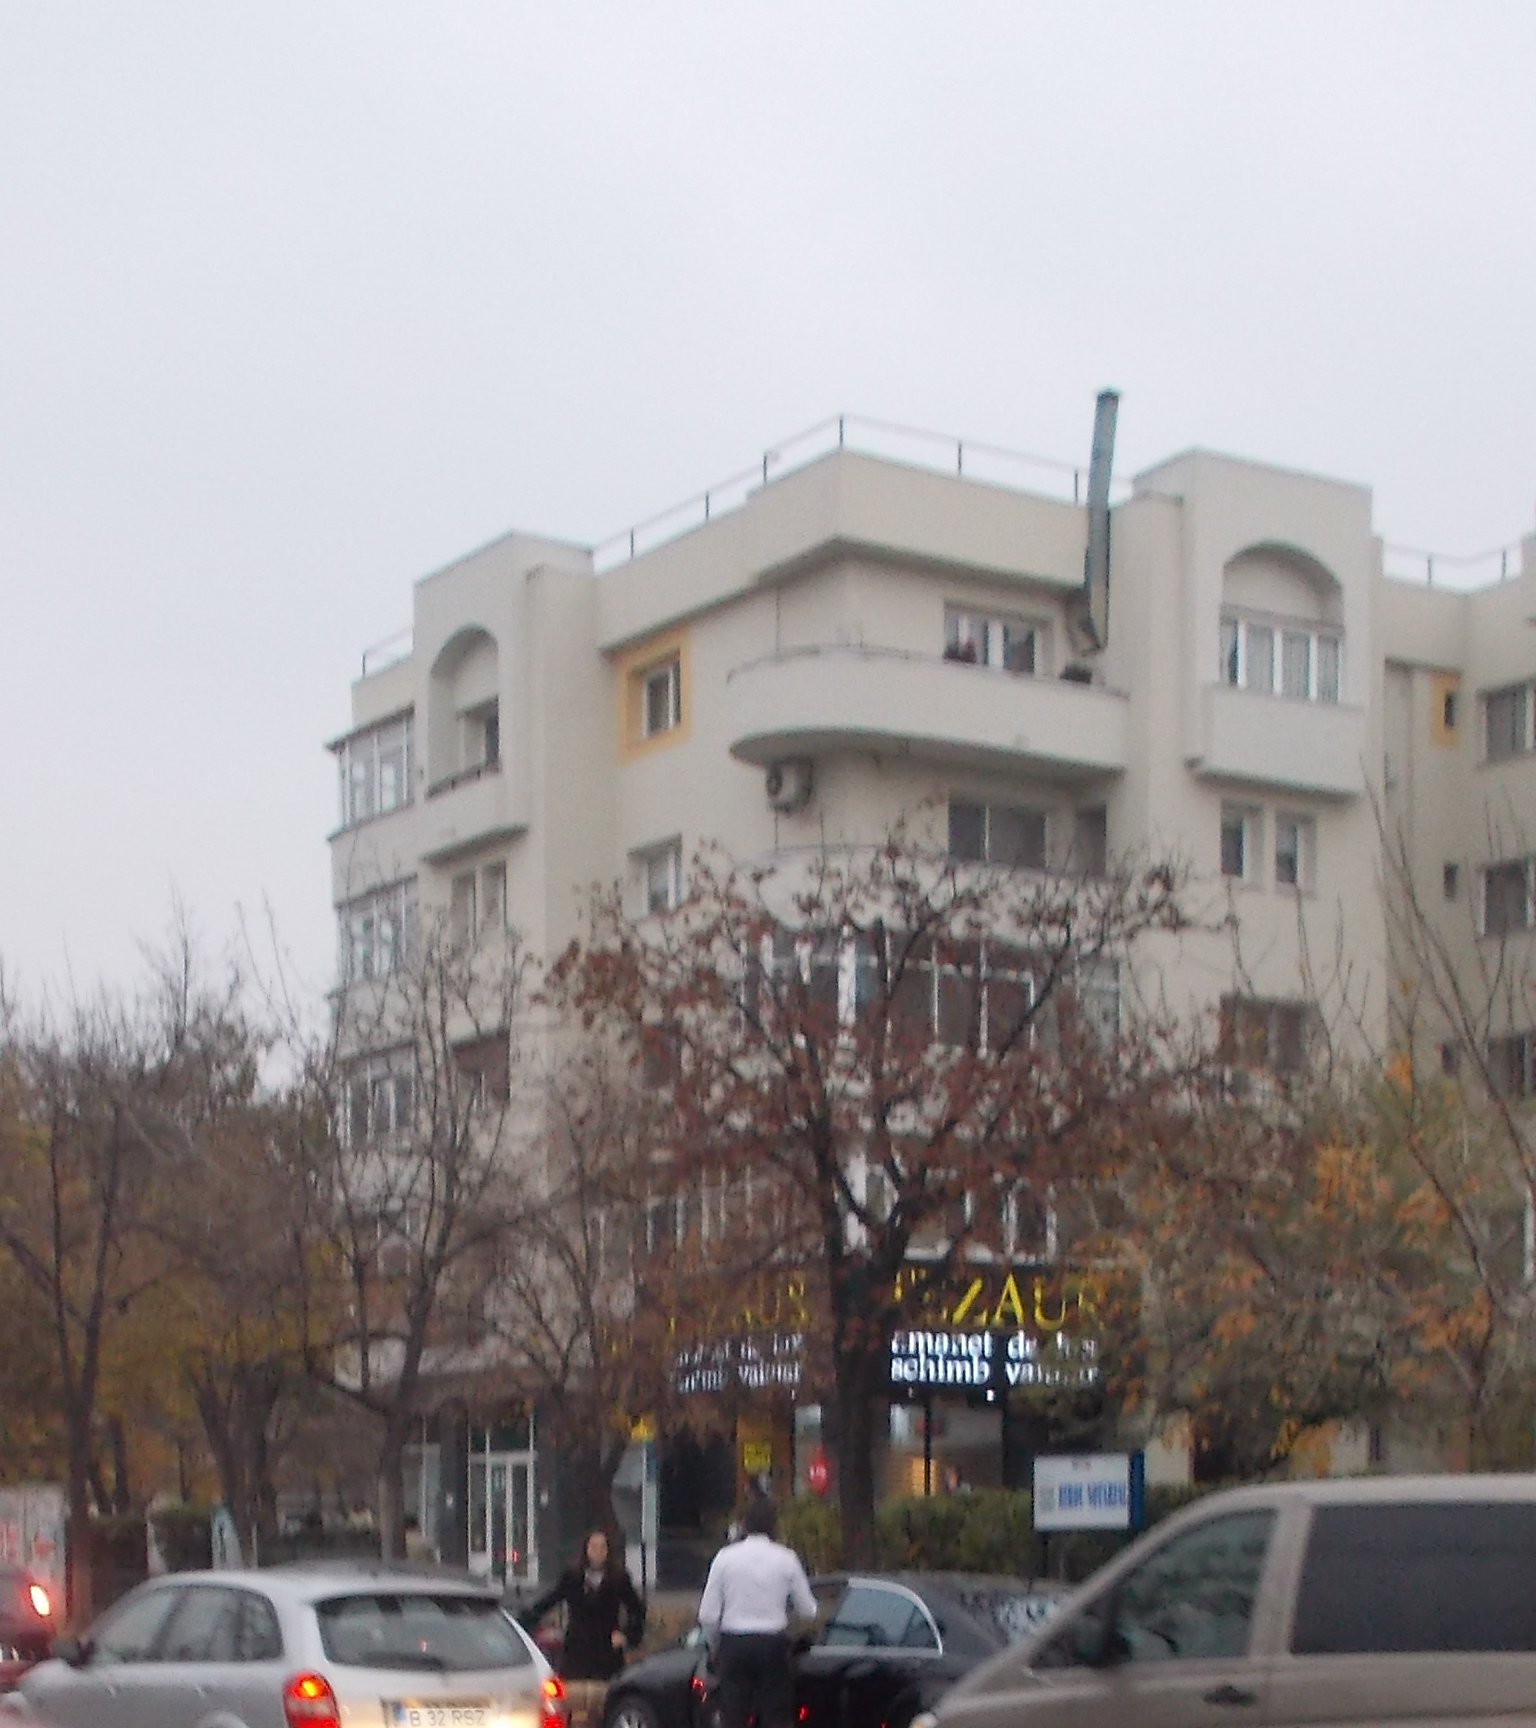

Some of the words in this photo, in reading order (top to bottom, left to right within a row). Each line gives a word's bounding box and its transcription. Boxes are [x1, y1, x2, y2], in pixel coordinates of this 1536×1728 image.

[409, 1710, 422, 1727] B
[427, 1710, 447, 1726] 32
[451, 1709, 486, 1726] RSZ
